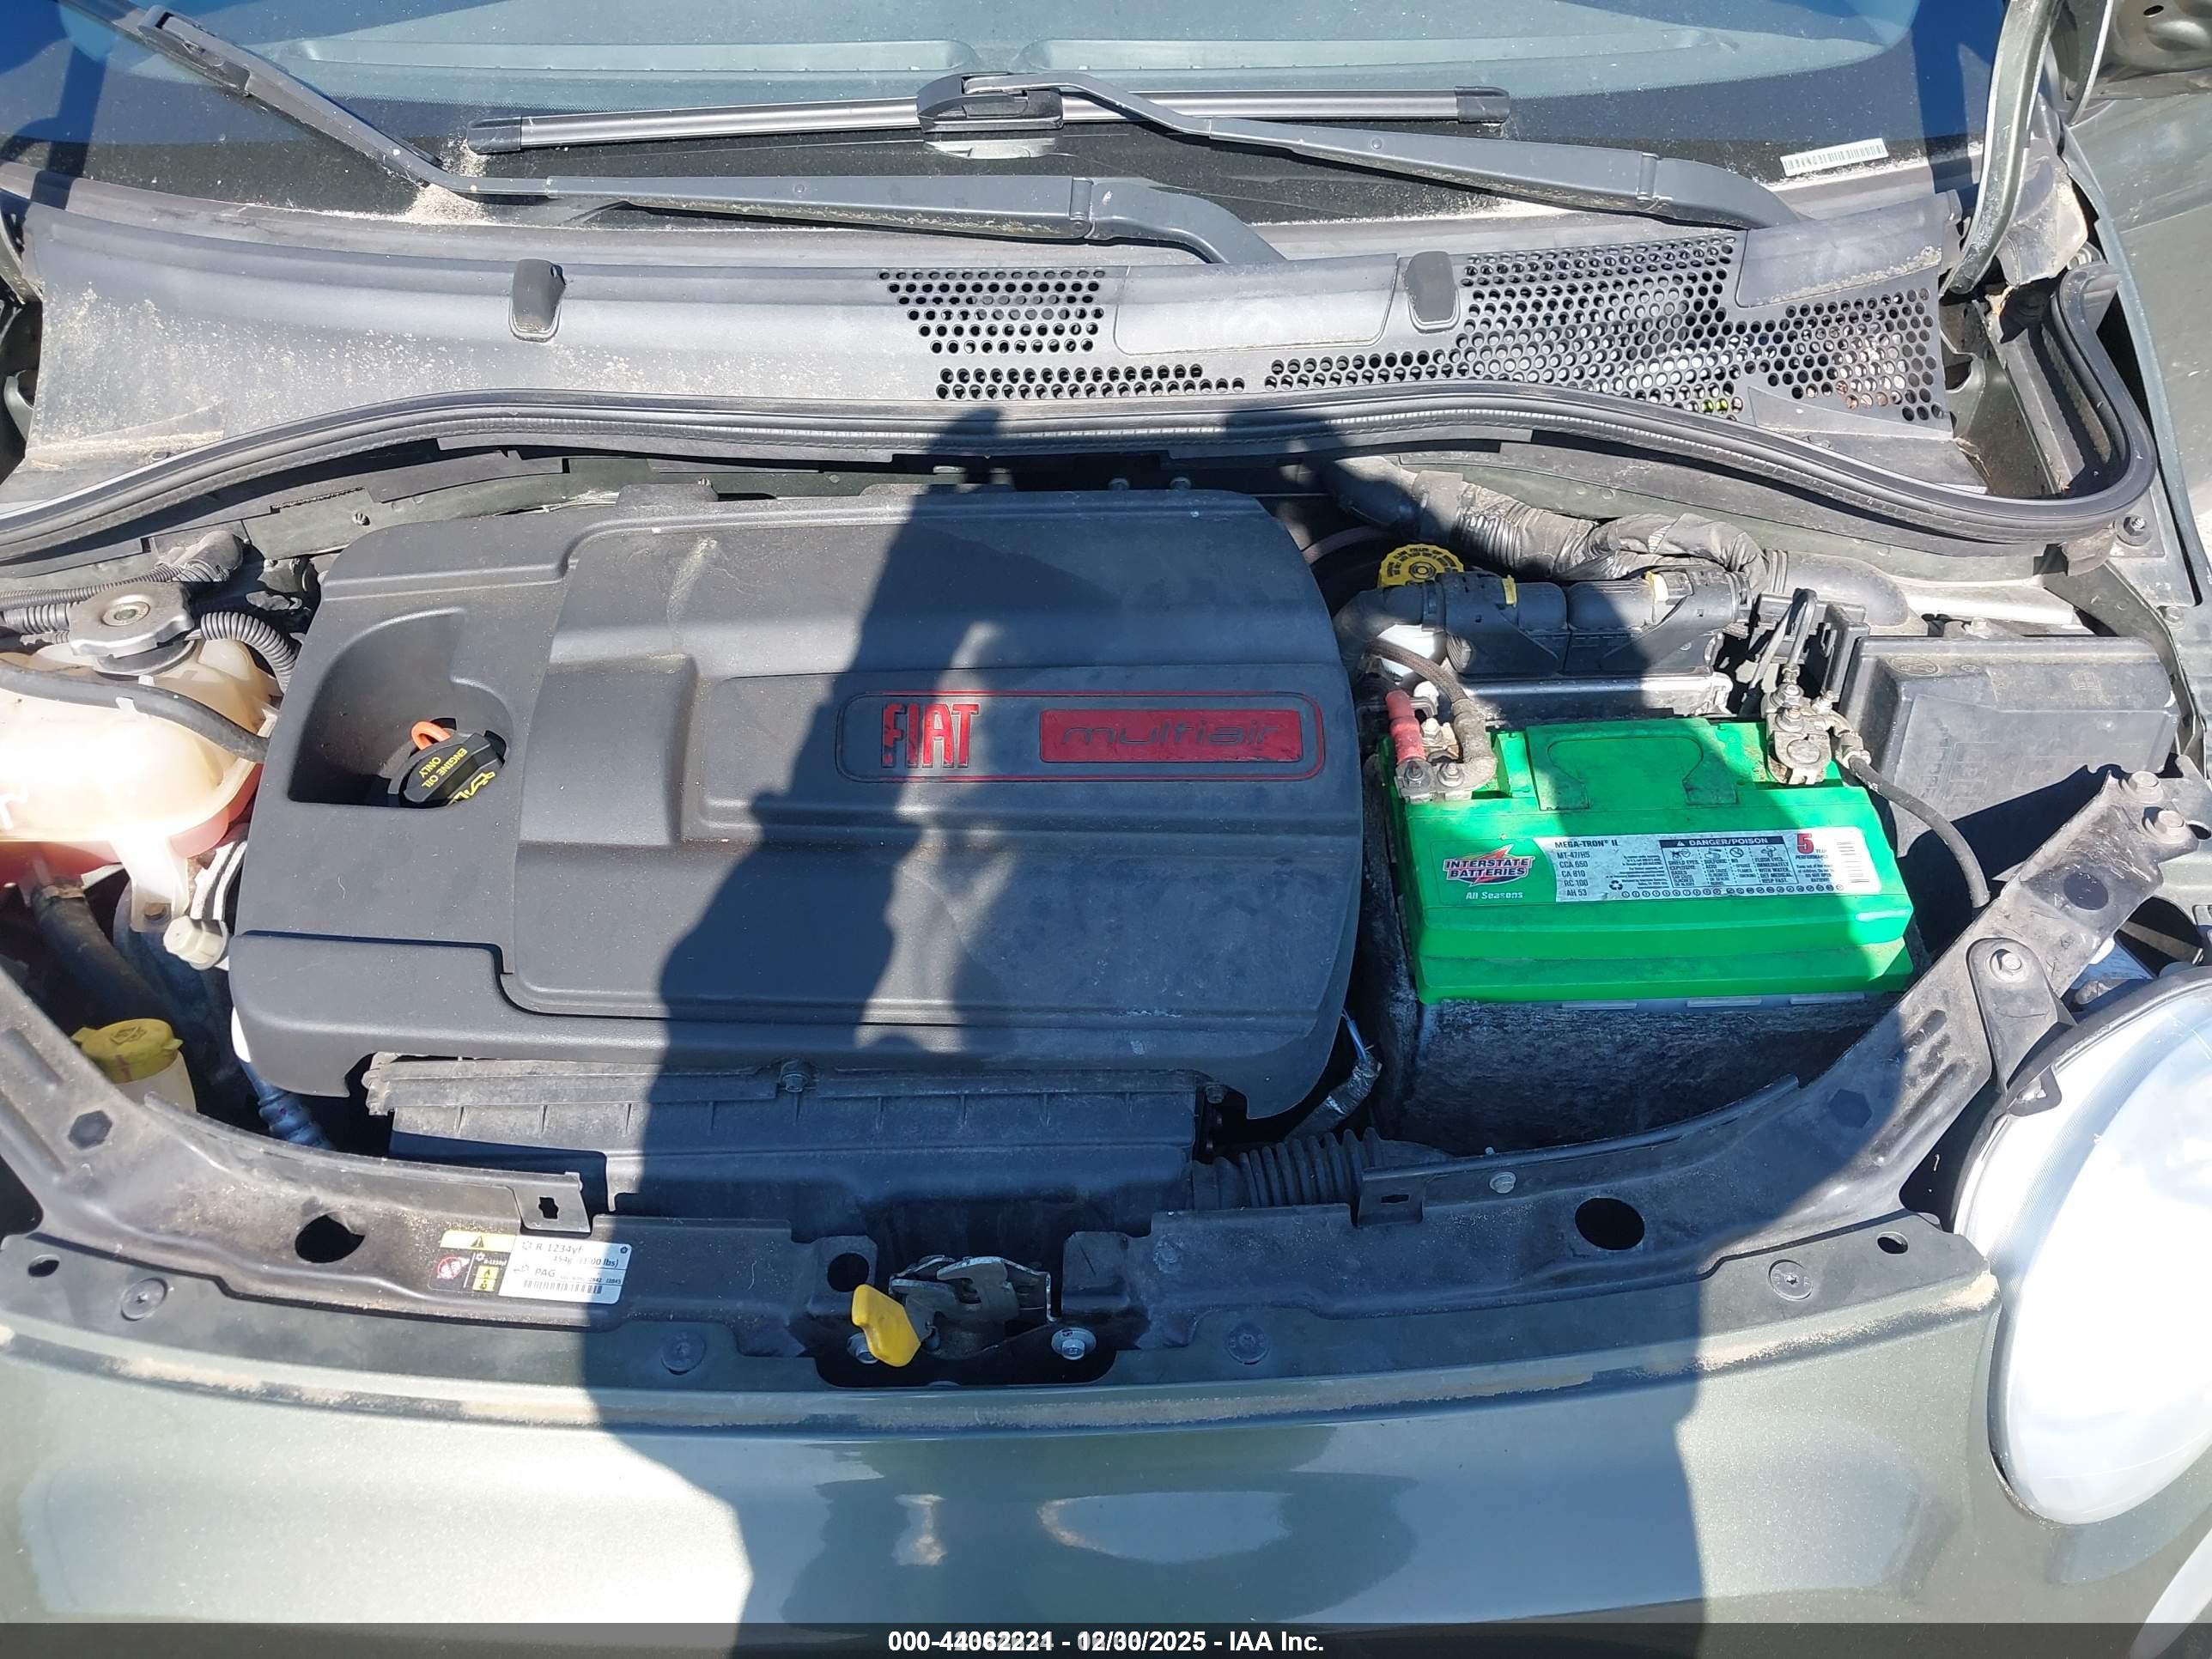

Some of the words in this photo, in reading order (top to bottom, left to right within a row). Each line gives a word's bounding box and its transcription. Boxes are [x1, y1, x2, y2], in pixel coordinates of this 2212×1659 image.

[881, 702, 980, 769] FIAT
[1061, 720, 1279, 746] multiair
[435, 747, 468, 776] ENGINE
[418, 757, 441, 778] ONLY
[421, 775, 439, 788] OIL
[1688, 837, 1769, 847] DANGER/POISON
[1796, 833, 1814, 854] 5
[1446, 858, 1528, 868] INTERSTATE
[1559, 860, 1573, 869] CCA
[1574, 860, 1589, 868] 650
[1450, 868, 1526, 878] BATTERIES
[1561, 869, 1572, 878] CA
[1564, 878, 1575, 887] RC
[1576, 878, 1589, 886] 100
[1465, 891, 1479, 900] All
[1481, 891, 1523, 900] Seasons
[1566, 888, 1577, 896] AH
[1578, 888, 1588, 896] 53
[603, 1257, 618, 1268] lbs)
[534, 1267, 556, 1278] PAG
